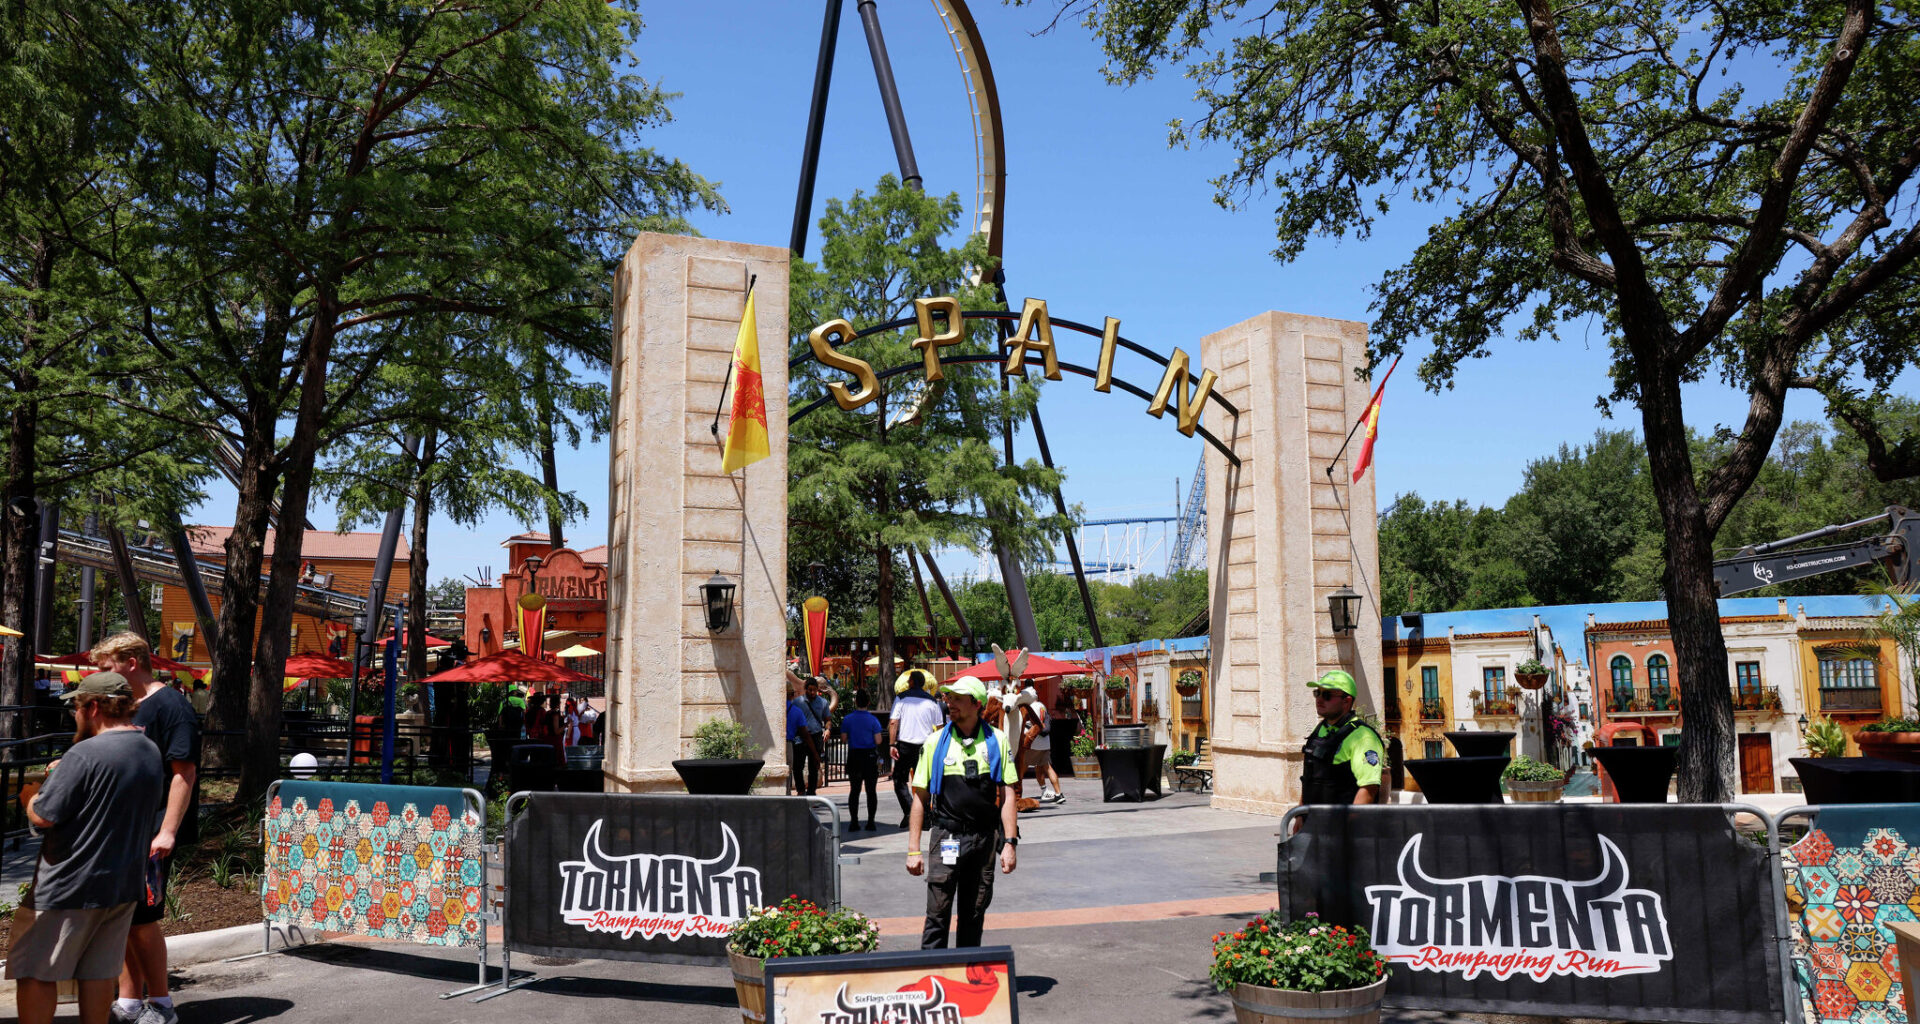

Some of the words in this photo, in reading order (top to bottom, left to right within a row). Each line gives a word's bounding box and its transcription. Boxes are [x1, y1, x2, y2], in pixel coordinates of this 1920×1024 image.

[809, 296, 1218, 438] SPAIN
[563, 858, 759, 917] TORMENTA
[568, 911, 685, 938] Rampaging
[686, 915, 730, 934] Run
[1370, 880, 1668, 955] TORMENTA
[1384, 946, 1554, 978] Rampaging
[1557, 950, 1655, 973] Run
[887, 994, 903, 1002] OVER
